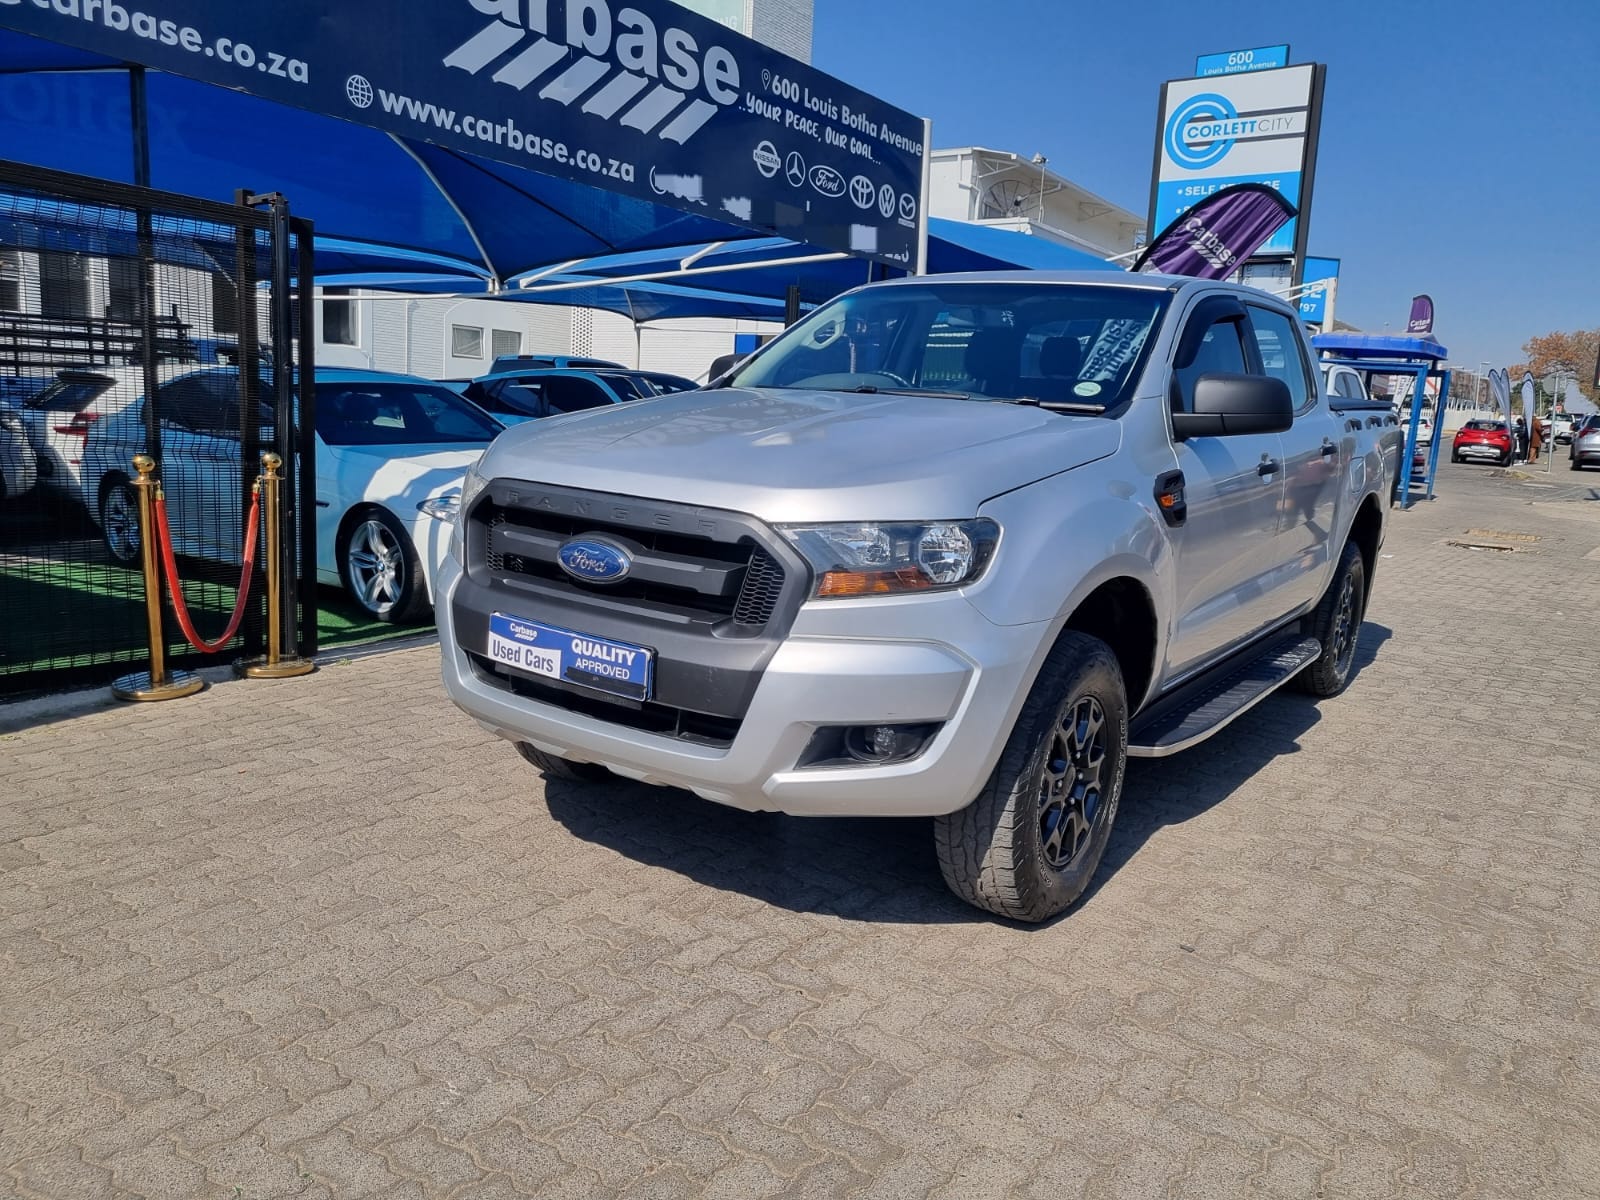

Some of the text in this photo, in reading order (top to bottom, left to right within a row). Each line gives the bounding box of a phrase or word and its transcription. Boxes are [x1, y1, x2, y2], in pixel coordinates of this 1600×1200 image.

[1204, 60, 1277, 75] Louis Botha Avenue
[1228, 51, 1253, 65] 600
[772, 75, 922, 157] 600 Louis Botha Avenue
[378, 88, 634, 182] www.carbase.co.za
[826, 126, 847, 149] OUR
[754, 151, 780, 166] NISSAN
[815, 169, 839, 192] Ford
[1185, 184, 1215, 196] SELF
[1186, 217, 1236, 266] Carbase
[507, 490, 716, 534] RANGER
[569, 546, 609, 573] Ford
[510, 623, 537, 637] Carbase
[493, 639, 553, 673] Used Cars
[571, 639, 636, 666] QUALITY
[576, 658, 630, 680] APPROVED
